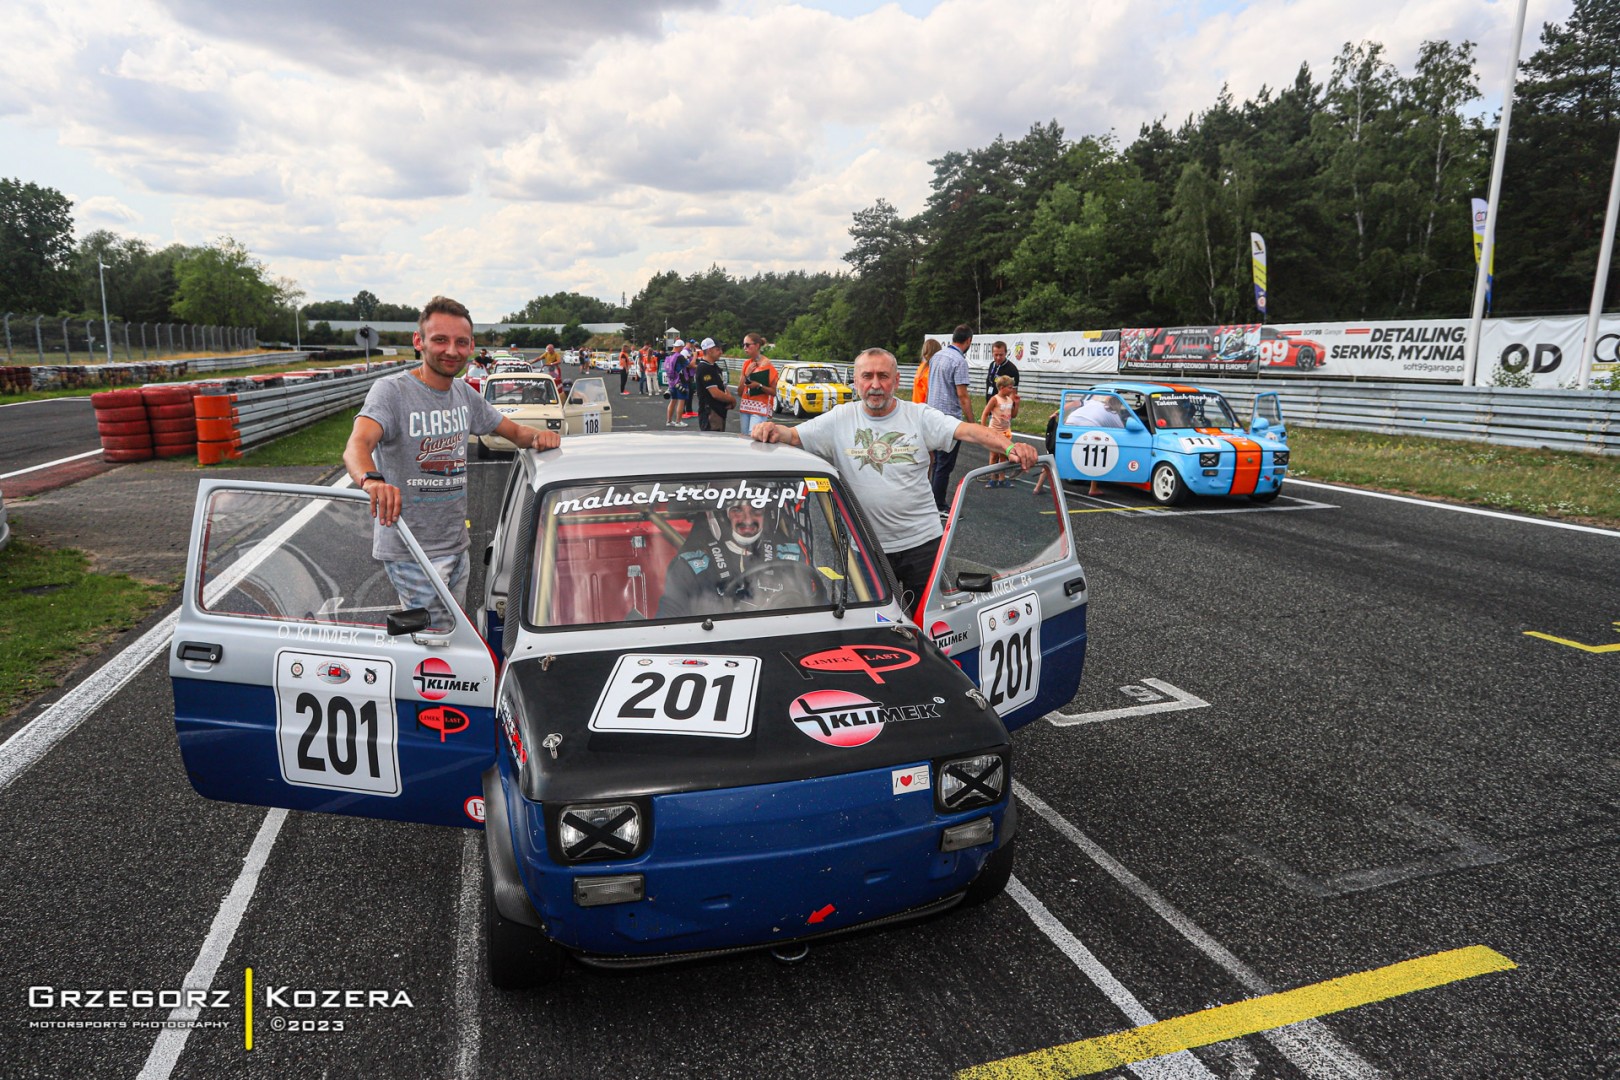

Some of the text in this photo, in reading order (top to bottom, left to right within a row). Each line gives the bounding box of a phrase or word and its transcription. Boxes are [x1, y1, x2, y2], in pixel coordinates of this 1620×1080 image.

[1370, 327, 1467, 344] DETAILING,
[1087, 346, 1114, 357] IVECO
[1260, 339, 1289, 366] 99
[1330, 345, 1465, 361] SERWIS, MYJNIA
[1501, 343, 1562, 374] OD
[1403, 363, 1465, 373] soft99garage.pl
[409, 405, 469, 437] CLASSIC
[585, 419, 599, 434] 108
[416, 432, 464, 462] Garage
[1186, 437, 1215, 446] 111
[1082, 444, 1108, 467] 111
[445, 478, 451, 486] &
[553, 480, 807, 515] maluch-trophy.pl
[939, 631, 968, 649] KLIMEK
[990, 627, 1033, 706] 201
[426, 679, 480, 693] KLIMEK
[617, 672, 736, 722] 201
[829, 703, 941, 729] KLIMEK
[296, 692, 381, 779] 201
